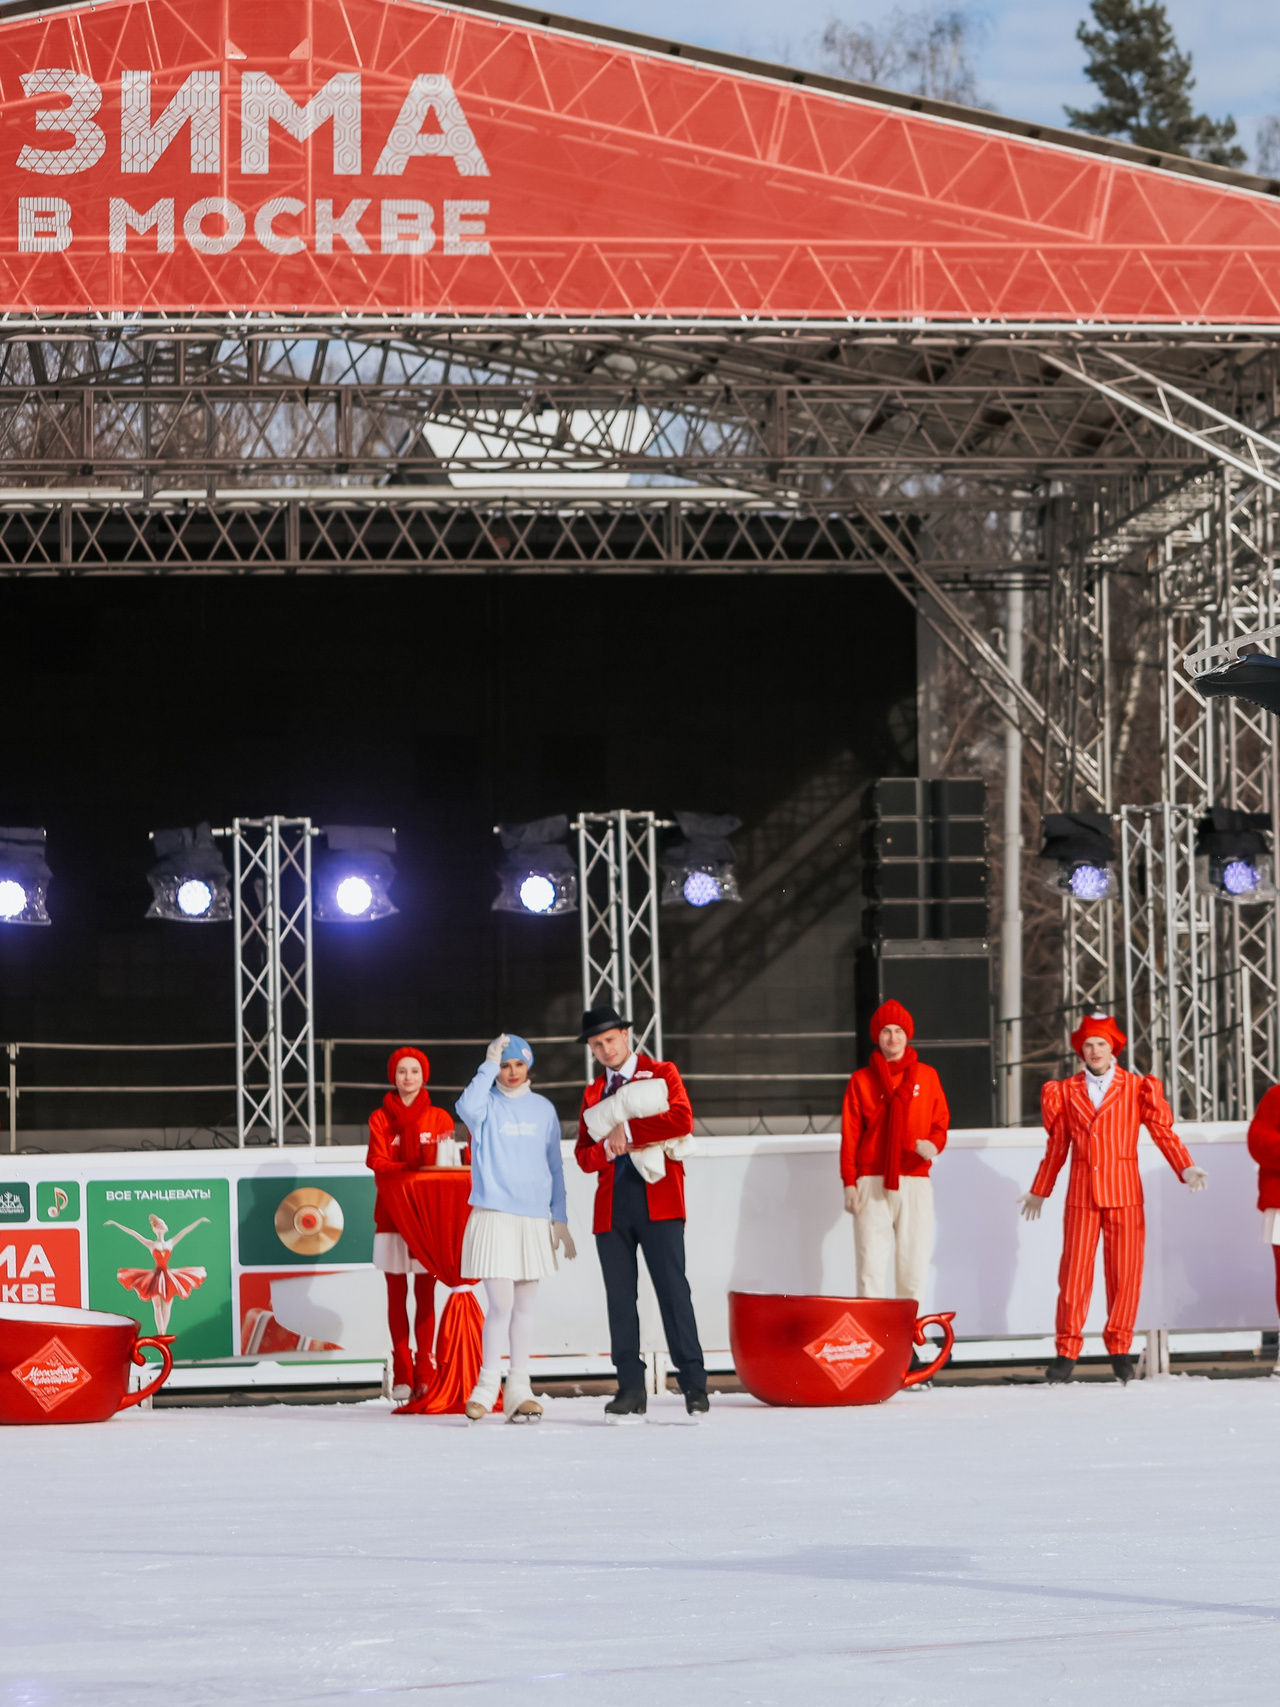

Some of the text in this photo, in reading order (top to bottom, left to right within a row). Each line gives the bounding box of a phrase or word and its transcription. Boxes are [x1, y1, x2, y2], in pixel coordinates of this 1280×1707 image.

[15, 68, 491, 177] ЗИМА
[18, 196, 490, 256] В МОСКВЕ
[106, 1188, 211, 1201] ВСЕ ТАНЦЕВАТЬ!
